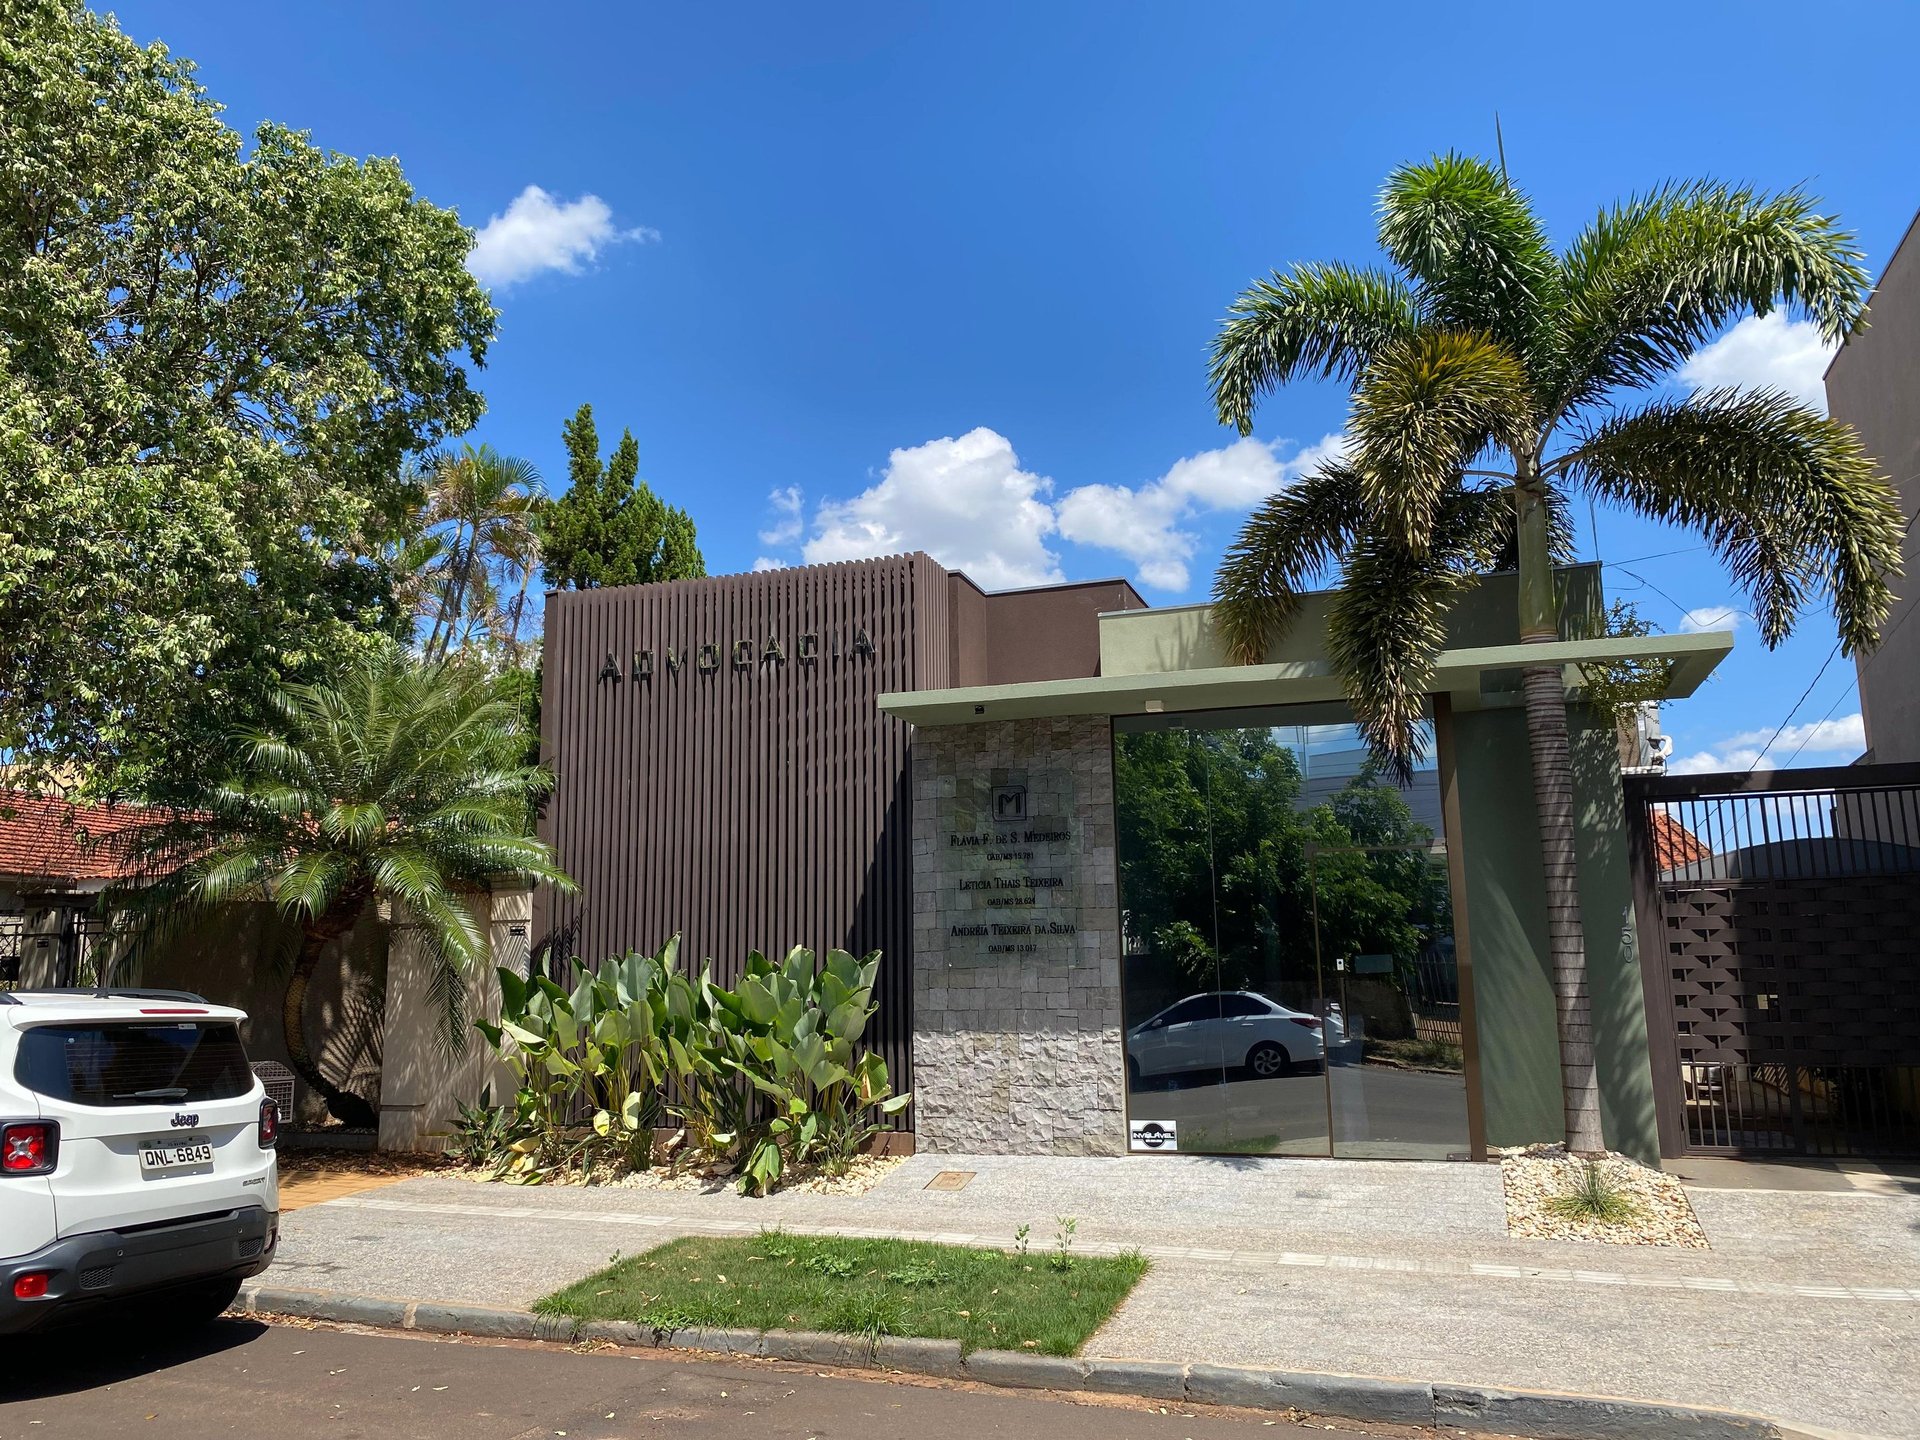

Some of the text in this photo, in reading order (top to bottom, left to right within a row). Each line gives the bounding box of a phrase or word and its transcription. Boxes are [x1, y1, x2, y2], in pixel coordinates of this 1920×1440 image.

[599, 628, 877, 678] ADVOCACIA
[950, 834, 980, 847] FLÁVIA
[996, 835, 1008, 844] DE
[1024, 831, 1071, 843] MEDEIROS
[987, 852, 1014, 862] OAB/MS
[1023, 876, 1064, 888] TEIXEIRA
[987, 897, 1014, 907] OAB/MS
[950, 922, 1076, 937] ANDRÉIA TEIXEIRA DA SILVA
[1621, 905, 1633, 963] 150
[988, 944, 1015, 954] OAB/MS
[170, 1112, 199, 1128] Jeep
